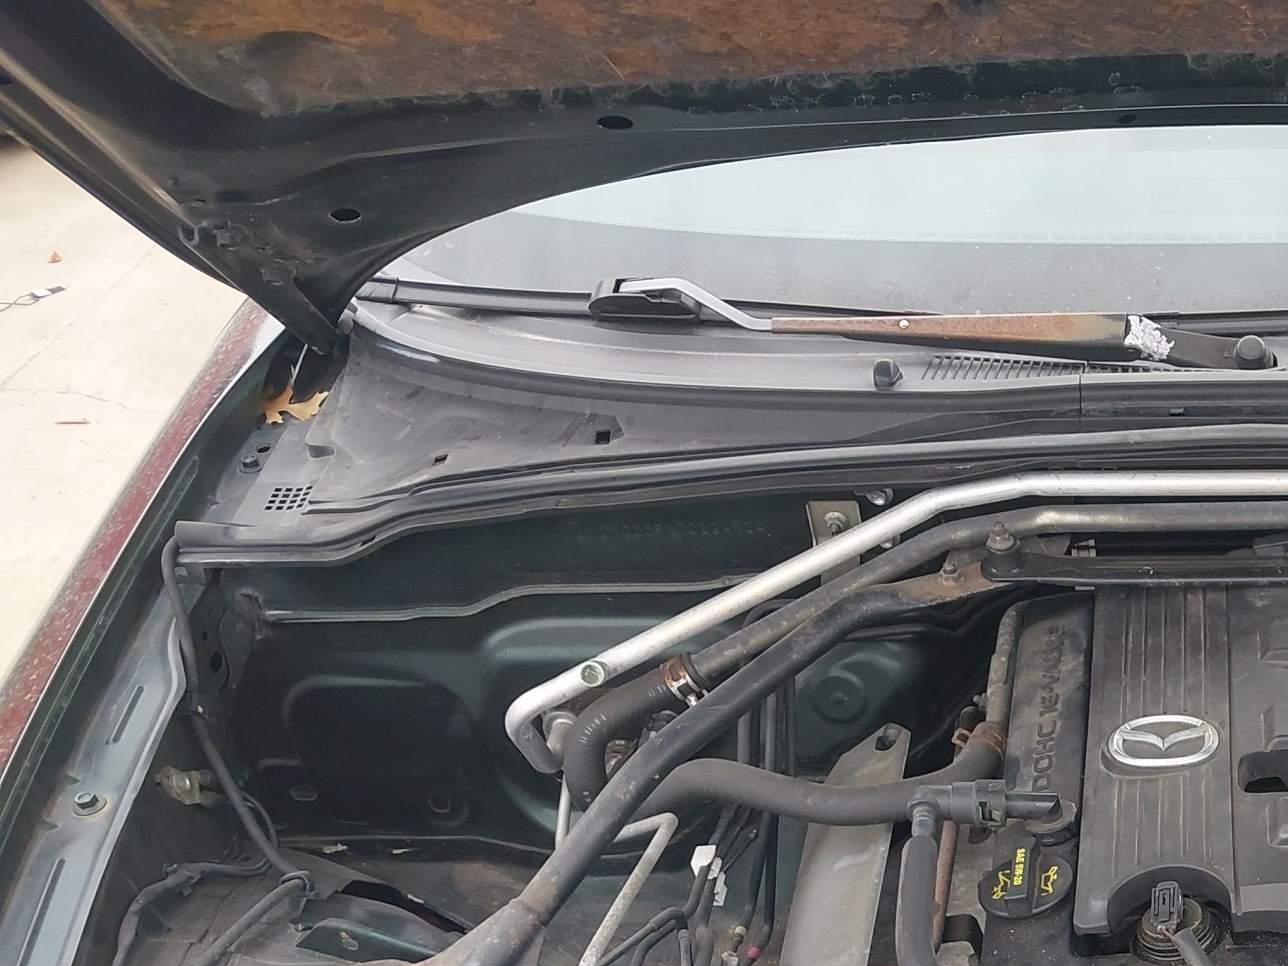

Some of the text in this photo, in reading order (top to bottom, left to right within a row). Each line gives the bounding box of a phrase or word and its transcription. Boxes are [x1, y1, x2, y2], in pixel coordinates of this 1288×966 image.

[1031, 719, 1057, 792] DOHC
[1013, 848, 1026, 886] SAE 5W-20
